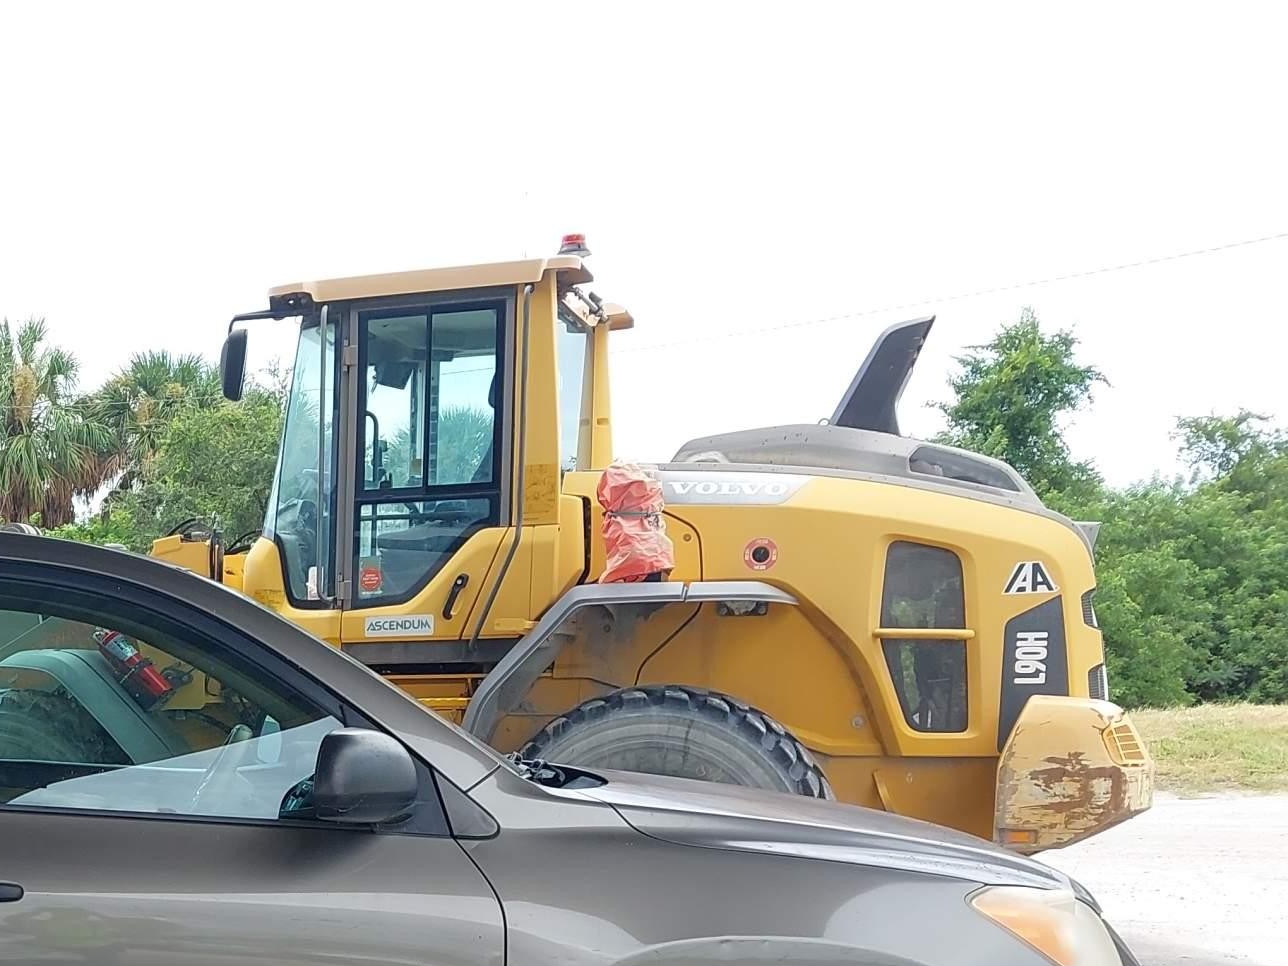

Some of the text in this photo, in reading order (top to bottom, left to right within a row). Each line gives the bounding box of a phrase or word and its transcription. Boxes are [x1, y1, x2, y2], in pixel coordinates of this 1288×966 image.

[668, 481, 789, 496] VOLVO
[366, 619, 431, 632] ASCENDUM
[1013, 631, 1049, 685] L90H
